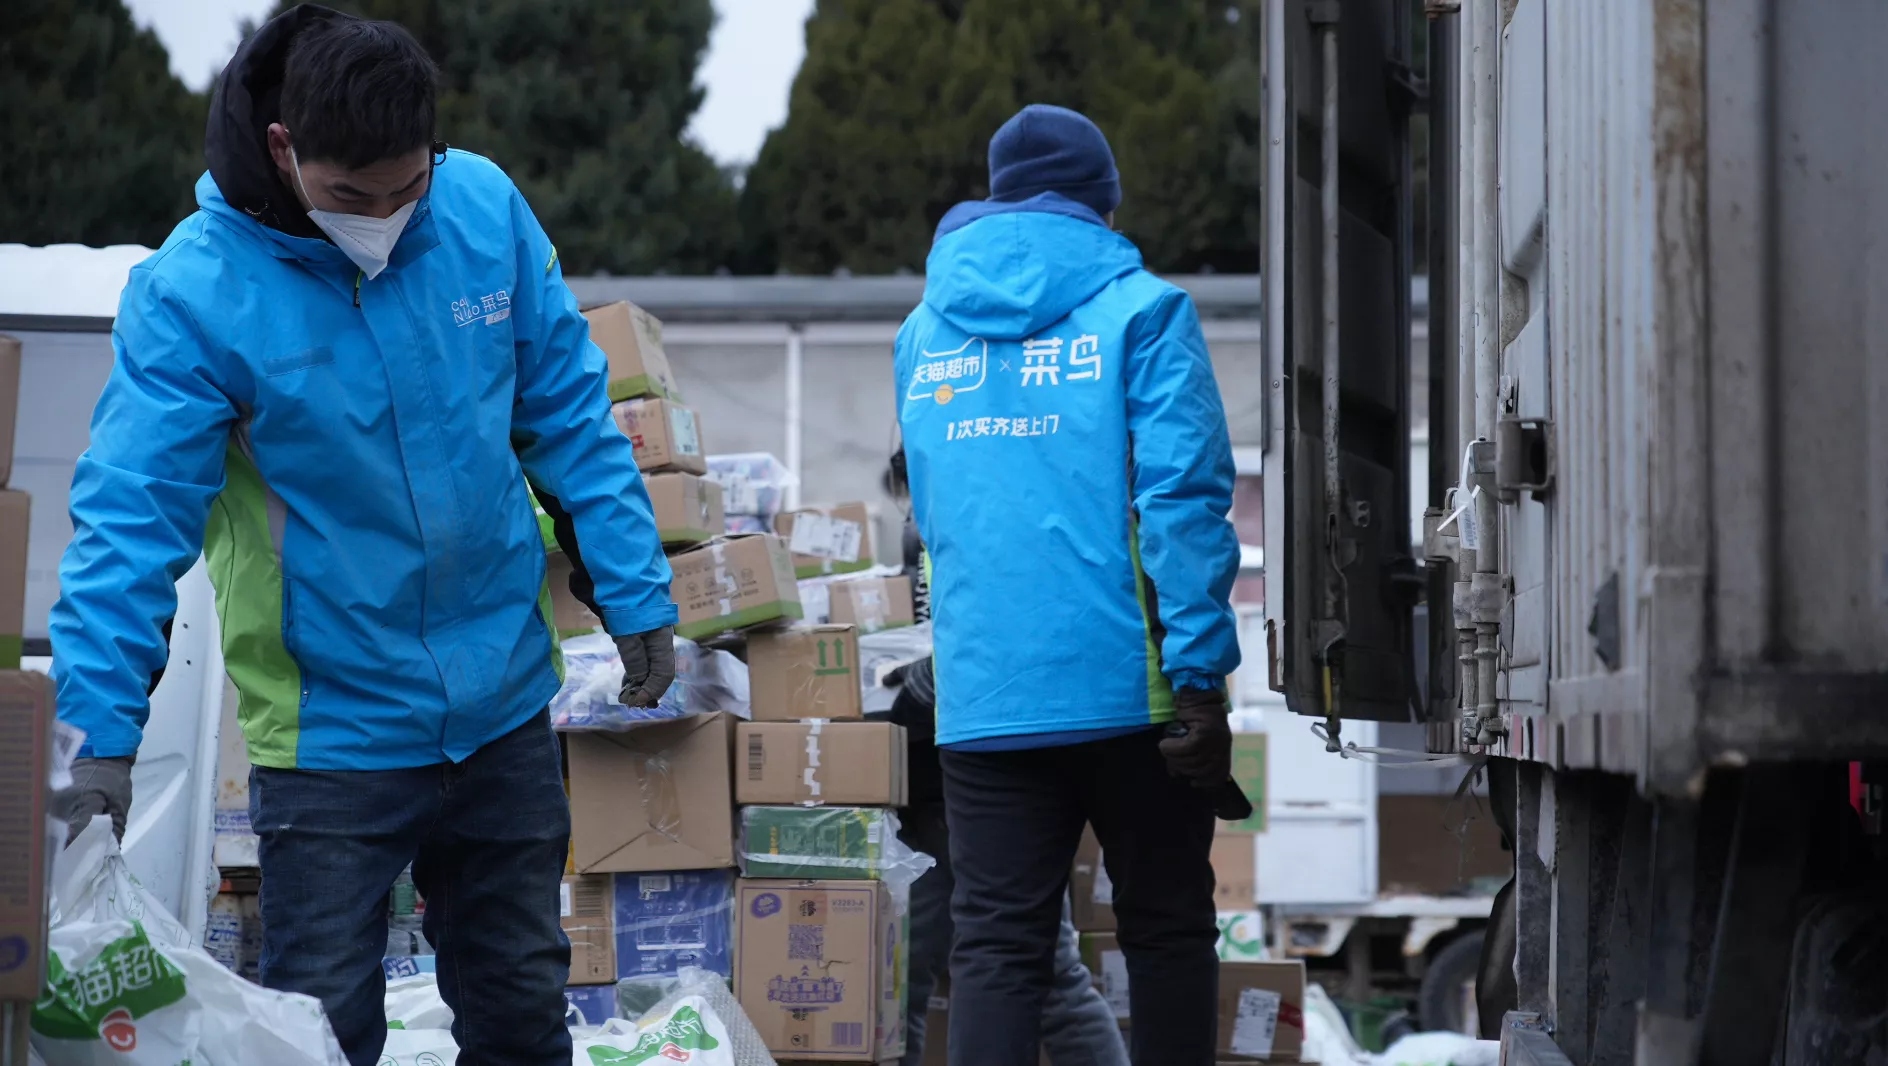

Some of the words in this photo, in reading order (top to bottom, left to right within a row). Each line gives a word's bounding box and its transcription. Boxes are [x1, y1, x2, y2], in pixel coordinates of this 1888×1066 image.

[480, 289, 510, 313] 菜鸟
[914, 355, 981, 384] 天猫超市
[1020, 334, 1102, 387] 菜鸟
[946, 414, 1060, 441] 1次买齐送上门
